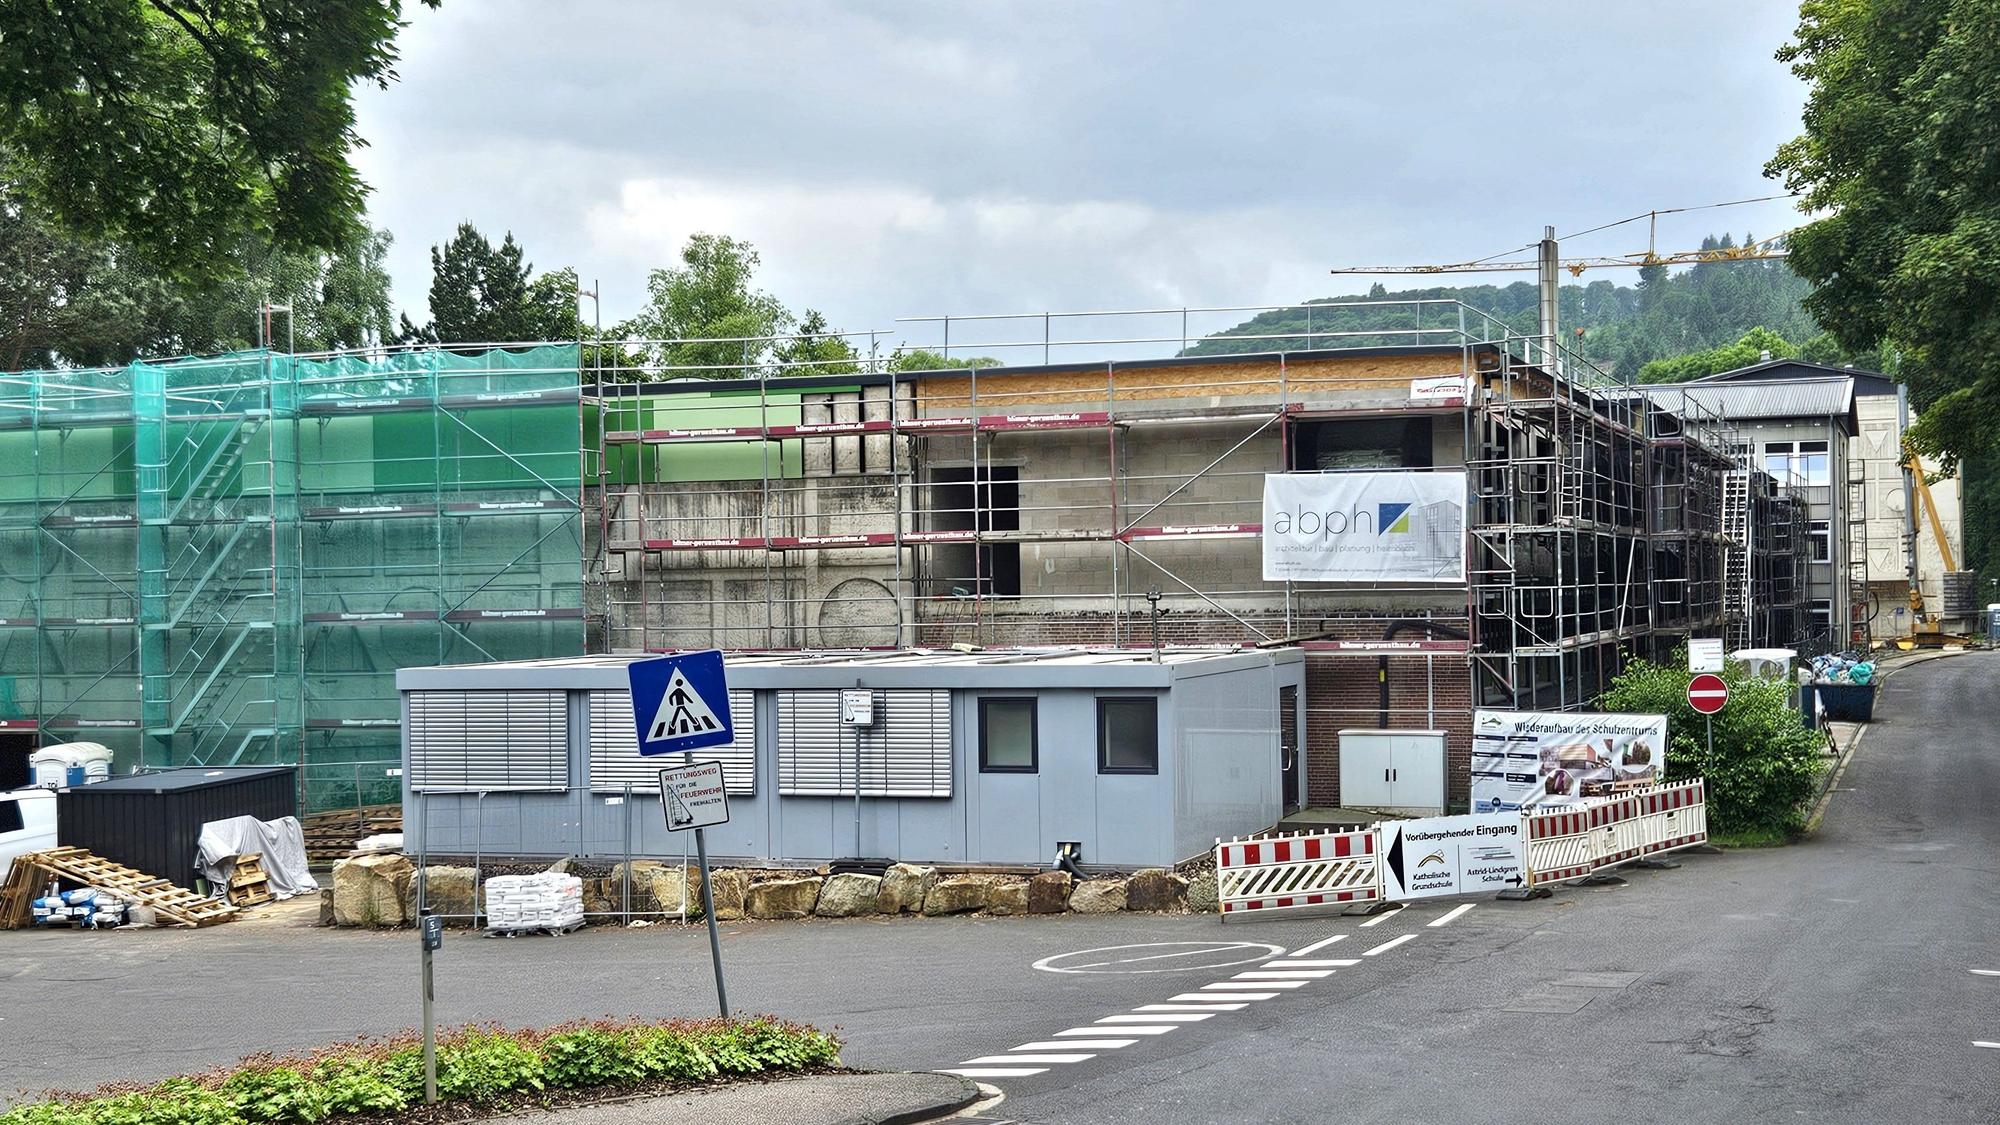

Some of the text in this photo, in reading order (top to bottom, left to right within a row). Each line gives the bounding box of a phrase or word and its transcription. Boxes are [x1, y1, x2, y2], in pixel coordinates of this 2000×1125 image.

[1274, 503, 1372, 542] abph
[1576, 724, 1590, 734] des
[1592, 724, 1658, 736] Schulzentrums
[665, 768, 717, 781] RETTUNGSWEG
[681, 787, 722, 799] FEUERWEHR
[1405, 825, 1517, 842] Vorübergehender Eingang
[1413, 872, 1451, 881] Katholische
[1467, 865, 1518, 876] Astrid-Lindgren
[1482, 874, 1504, 883] Schule
[1411, 881, 1453, 891] Grundschule
